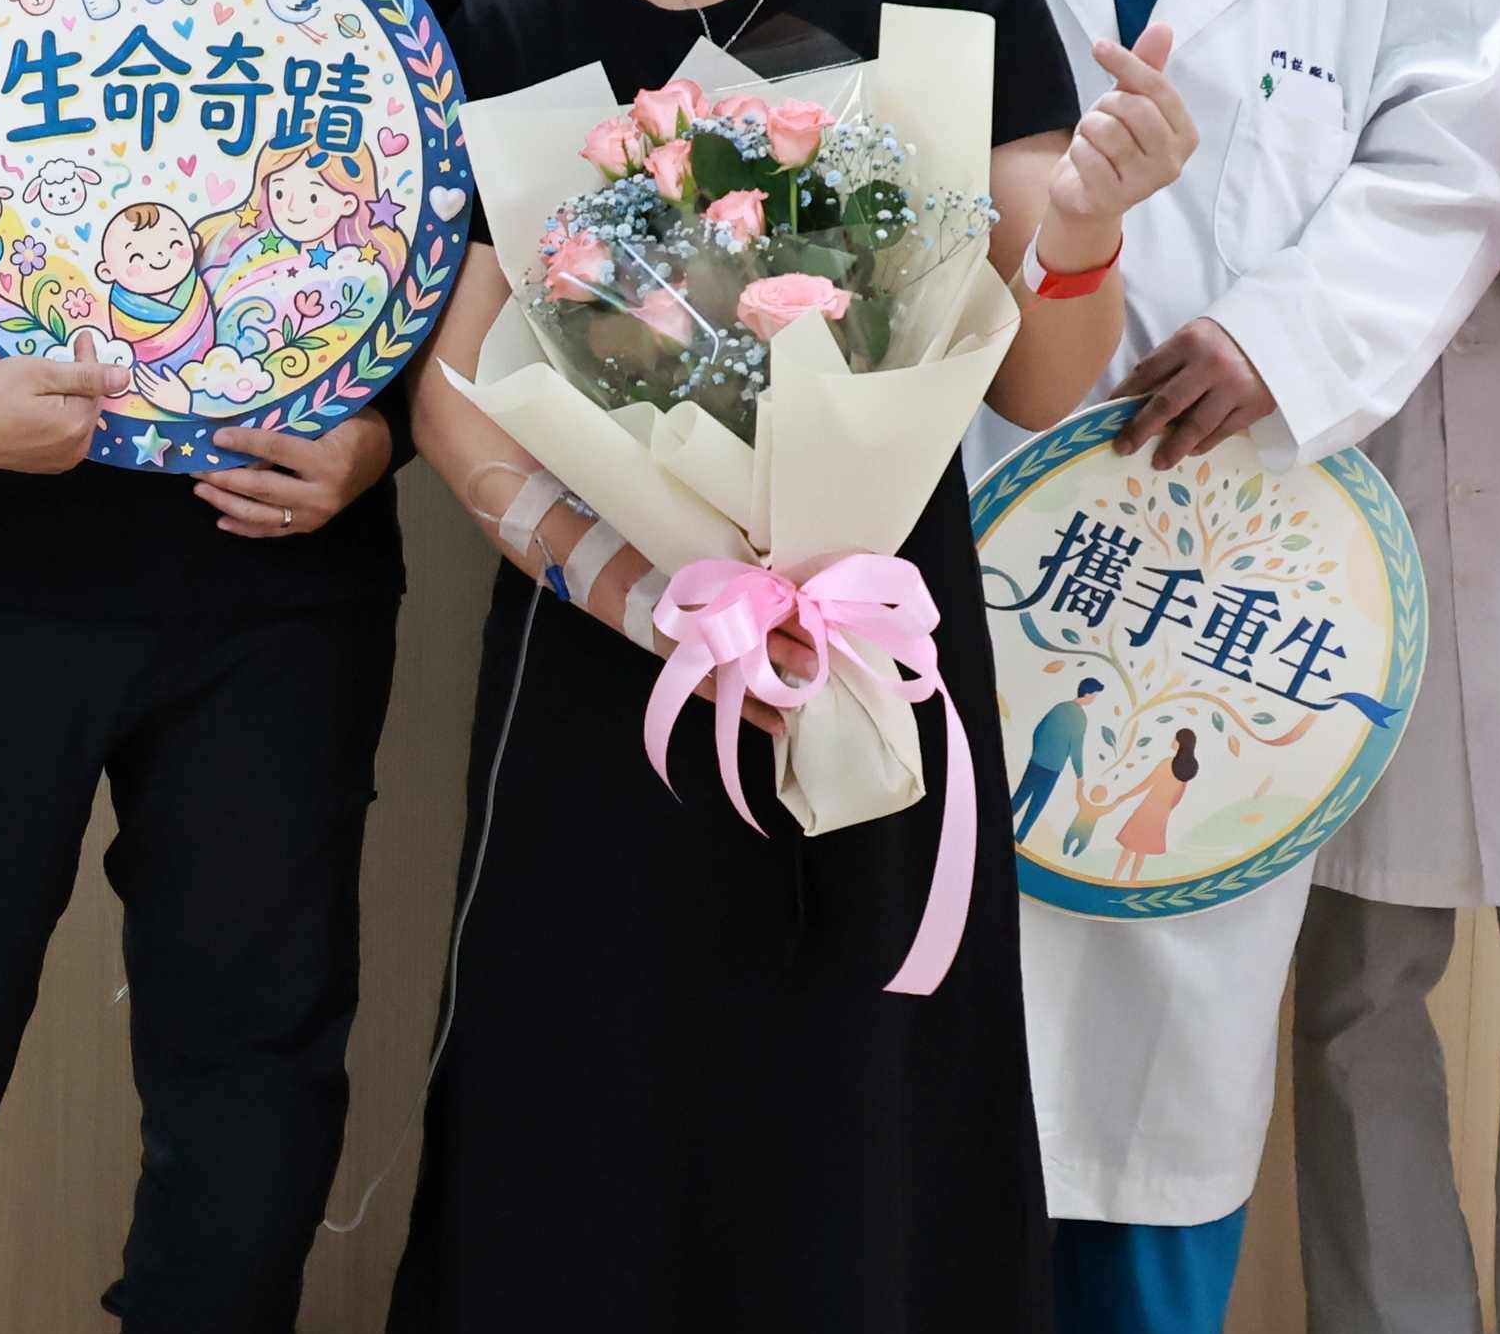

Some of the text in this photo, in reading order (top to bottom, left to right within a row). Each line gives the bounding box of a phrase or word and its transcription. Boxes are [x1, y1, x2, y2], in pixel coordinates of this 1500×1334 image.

[0, 23, 375, 180] 生命奇蹟
[1022, 509, 1348, 713] 攜手重生
